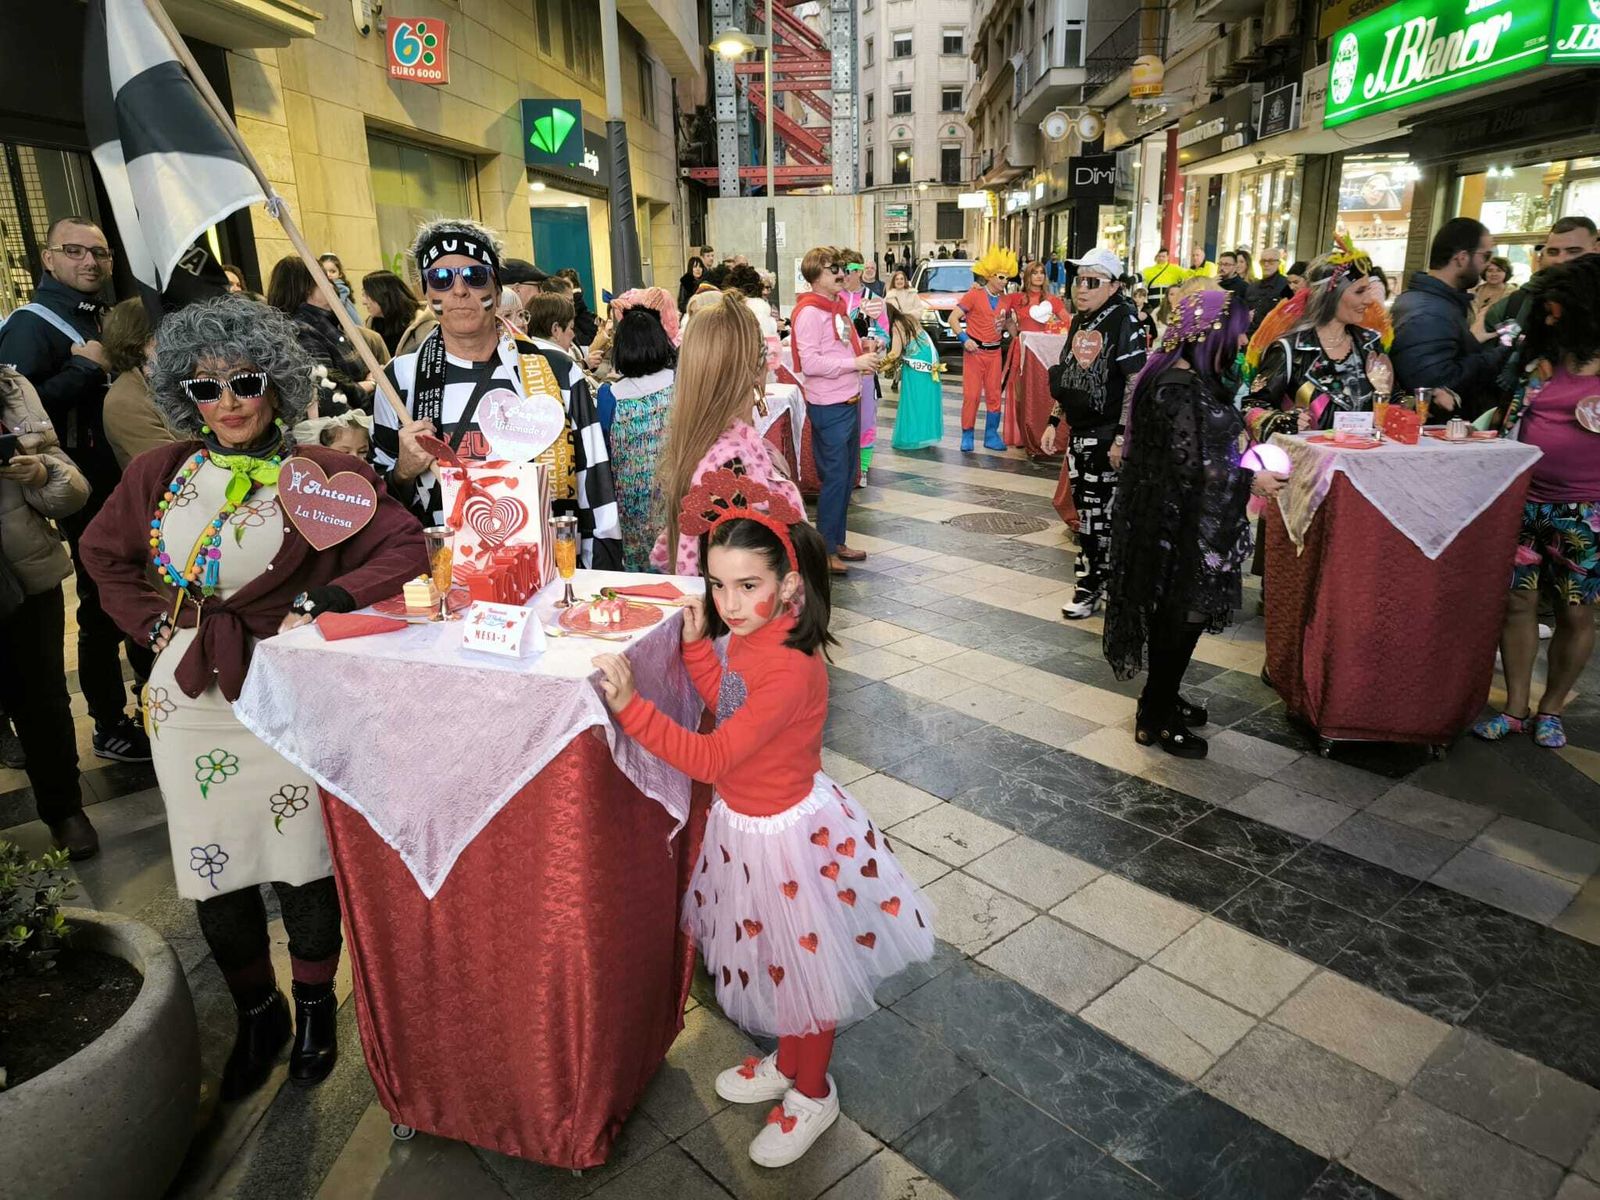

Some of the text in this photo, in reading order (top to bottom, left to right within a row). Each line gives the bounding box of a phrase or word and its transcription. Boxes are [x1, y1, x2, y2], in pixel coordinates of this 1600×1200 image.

[391, 65, 442, 79] EURO 6000
[1075, 167, 1116, 185] Dimi
[423, 239, 493, 268] CEUTA
[78, 301, 96, 312] HH
[303, 479, 372, 507] Antonia
[294, 505, 353, 528] La Viciosa
